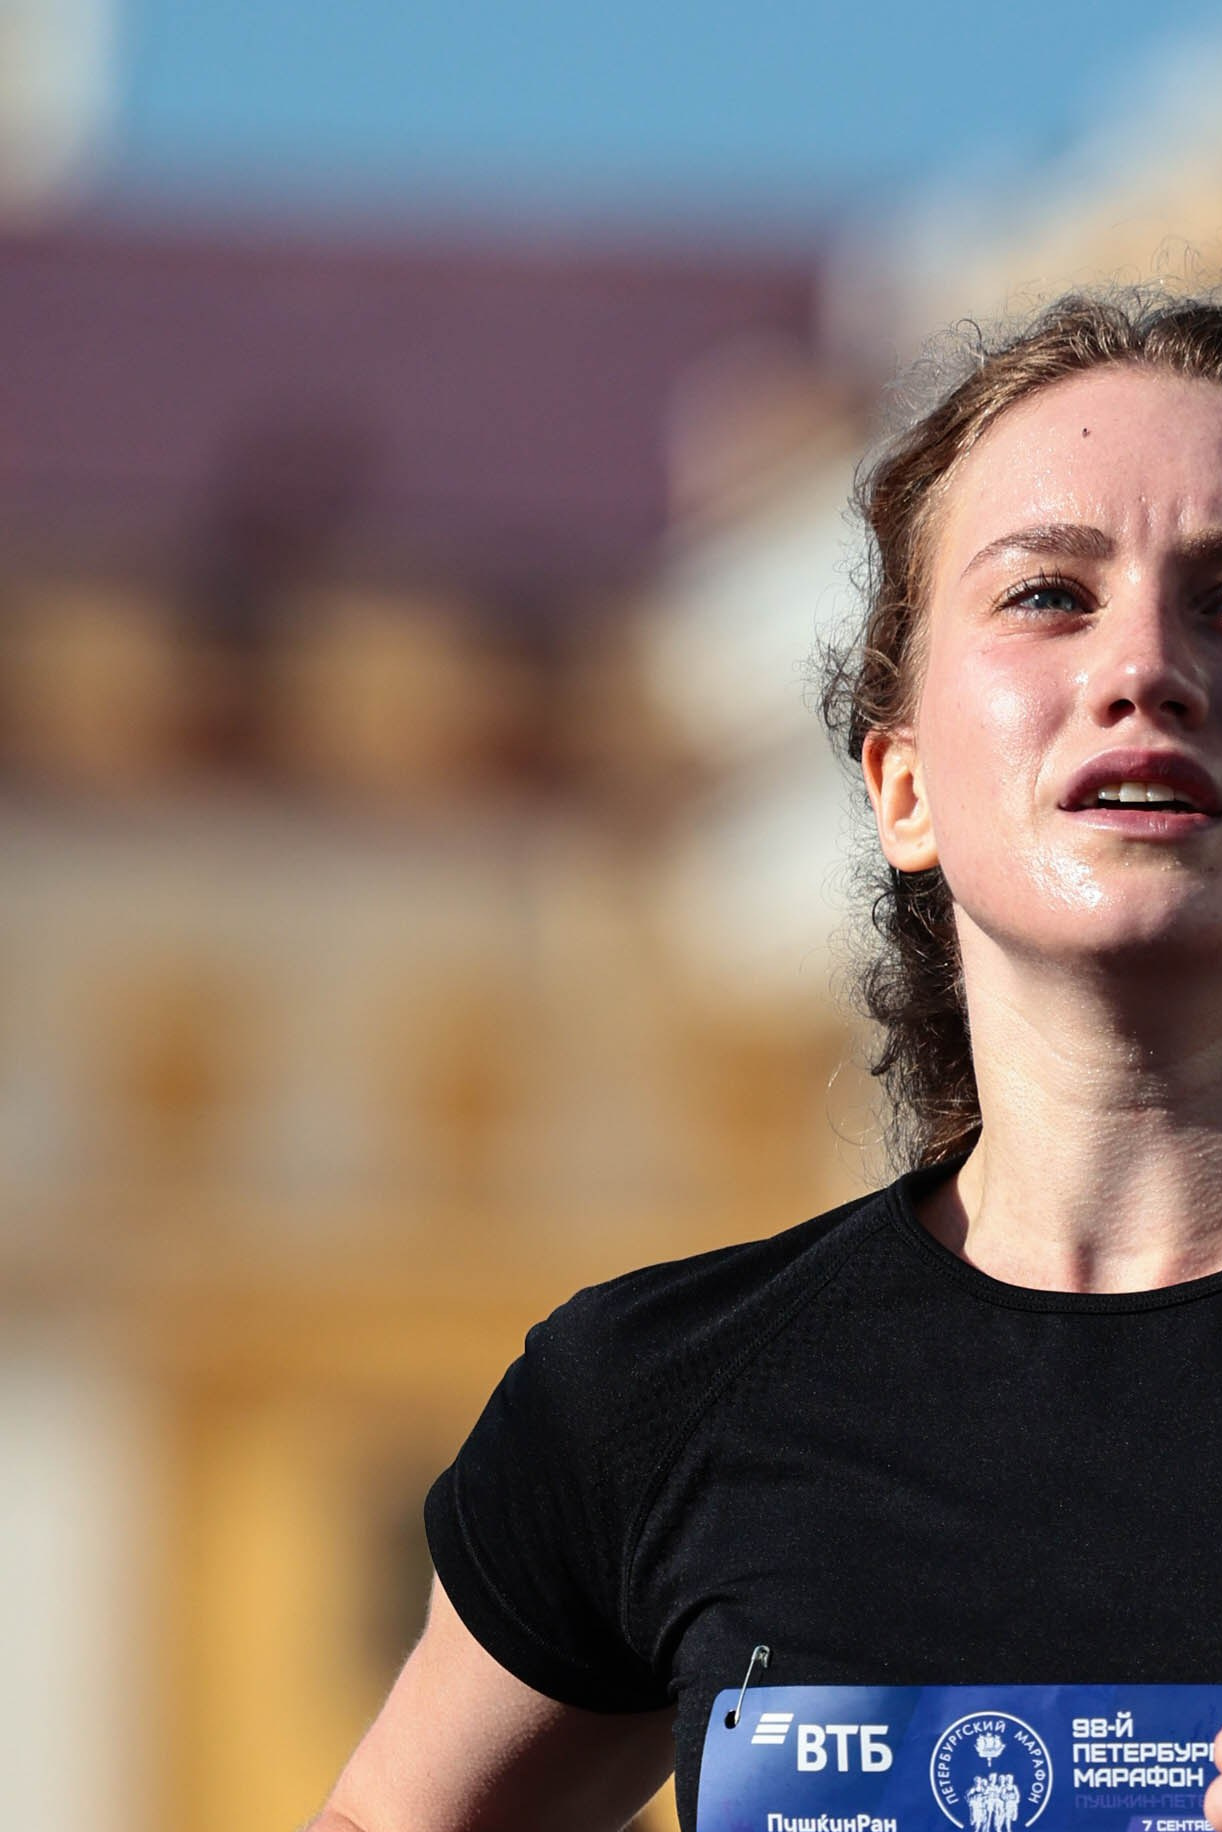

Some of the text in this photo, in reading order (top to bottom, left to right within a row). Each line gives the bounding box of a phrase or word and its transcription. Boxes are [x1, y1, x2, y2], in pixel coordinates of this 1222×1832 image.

[1072, 1711, 1133, 1738] 98-Й
[797, 1724, 893, 1772] ВТБ
[937, 1720, 1046, 1805] ПЕТЕРБУРГСКИЙ МАРАФОН
[1073, 1765, 1204, 1788] МАРАФОН
[1075, 1793, 1204, 1808] ПУШКИН-ПЕТ
[1142, 1820, 1152, 1832] 7
